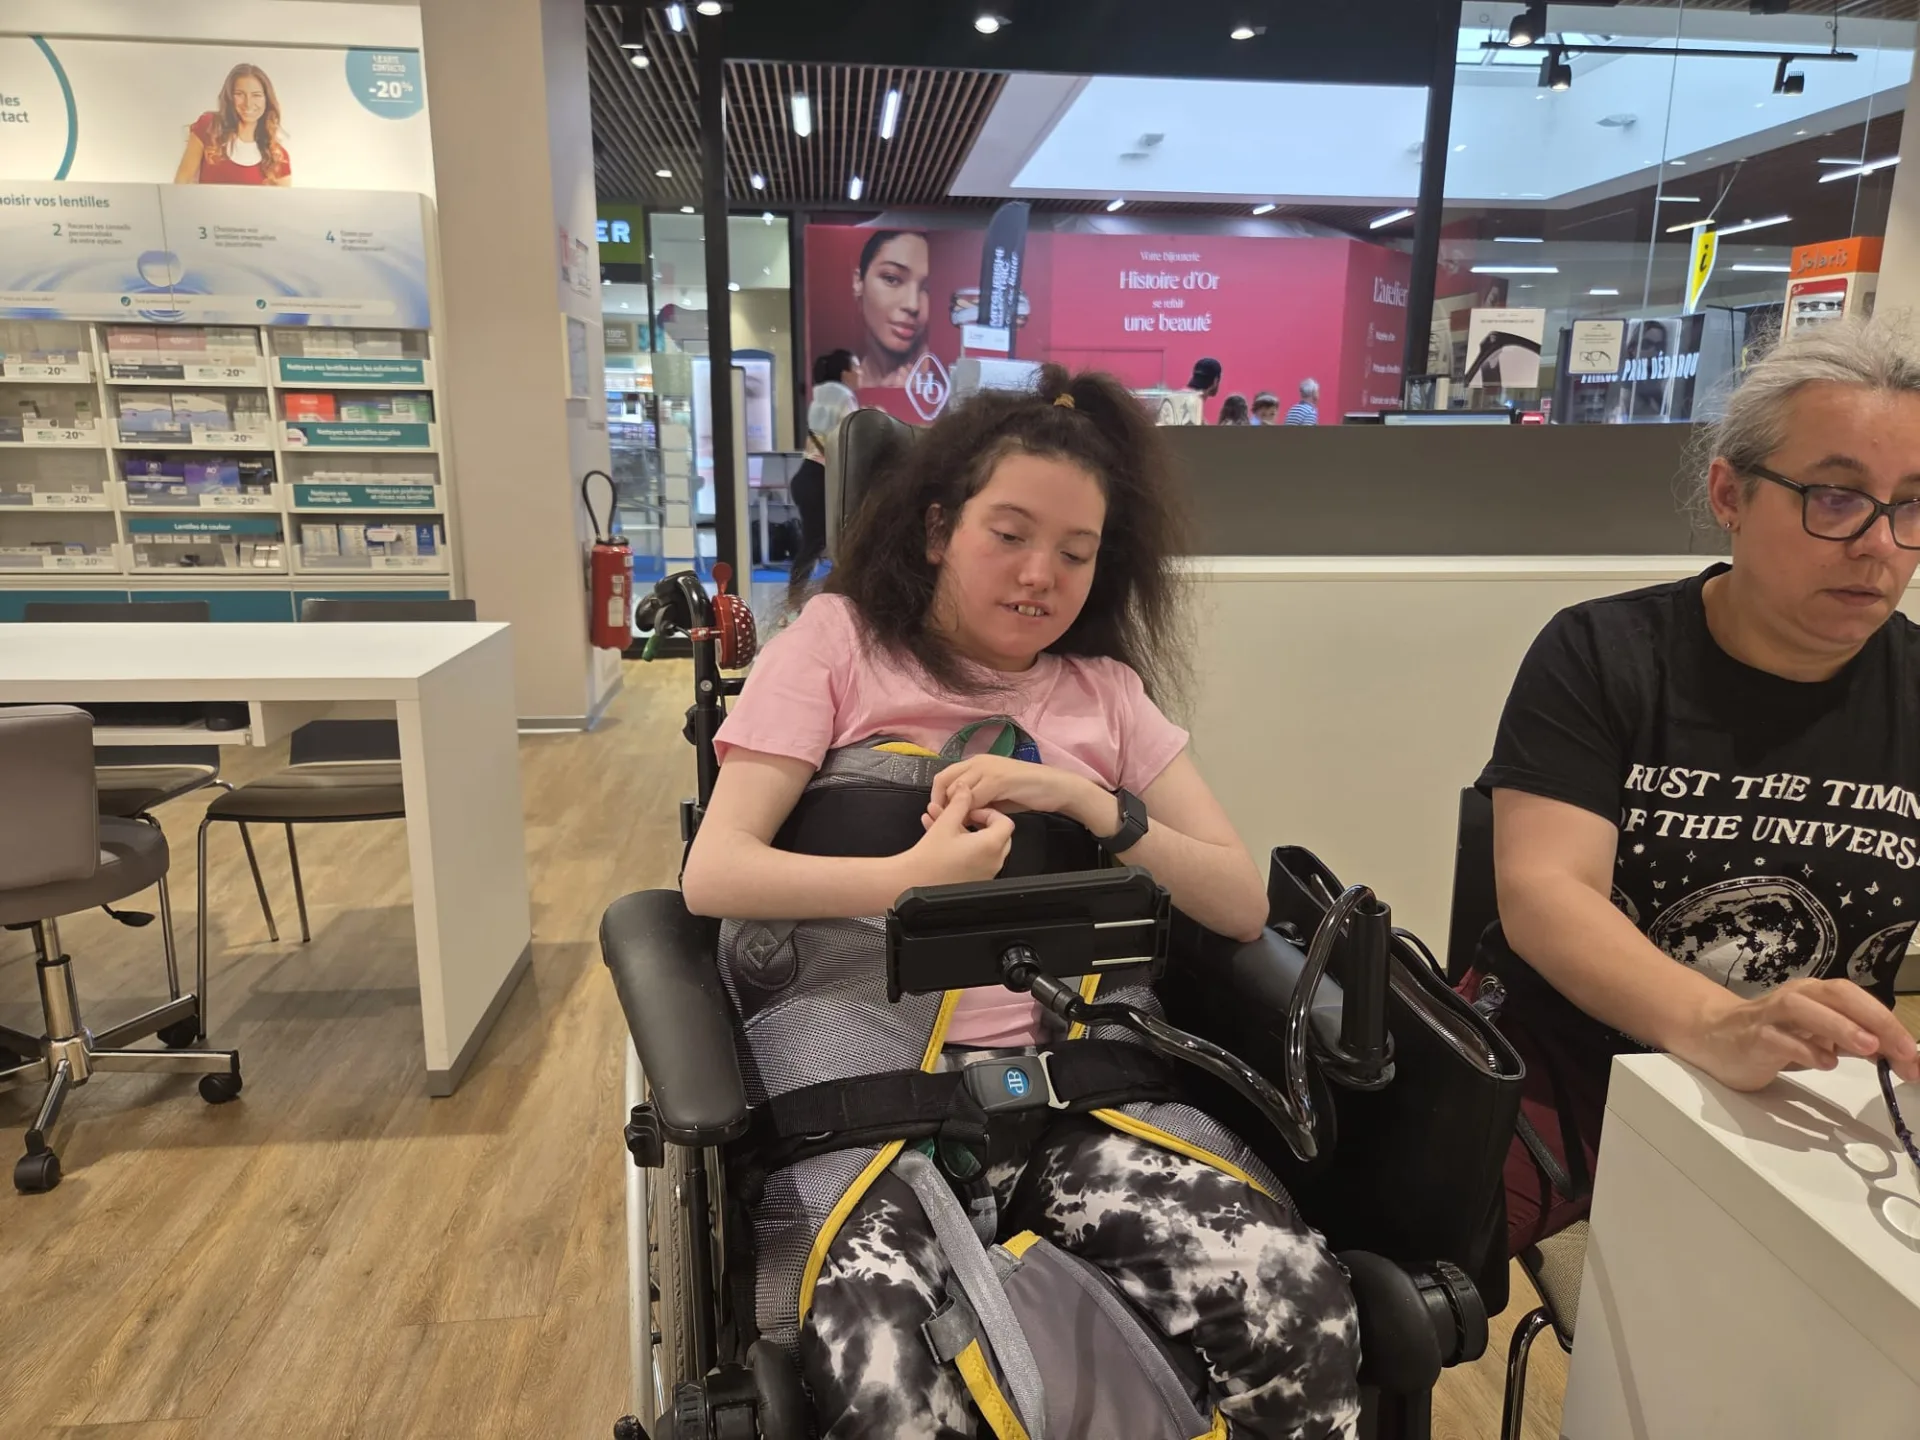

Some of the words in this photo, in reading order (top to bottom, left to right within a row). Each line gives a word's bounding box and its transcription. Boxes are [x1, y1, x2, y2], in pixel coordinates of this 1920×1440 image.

[34, 198, 56, 207] vos
[60, 195, 110, 208] lentilles
[52, 223, 62, 236] 2
[198, 226, 207, 239] 3
[325, 231, 335, 244] 4
[596, 220, 631, 243] ER
[1797, 249, 1848, 274] Solaris
[1120, 270, 1180, 289] Histoire
[1182, 271, 1220, 290] d'Or
[1152, 301, 1162, 309] se
[1124, 316, 1155, 331] une
[1158, 312, 1212, 331] beauté
[1624, 763, 1720, 798] RUST
[1731, 773, 1811, 801] THE
[1619, 807, 1647, 832] F
[1653, 810, 1742, 840] THE
[1751, 815, 1920, 870] UNIVERS
